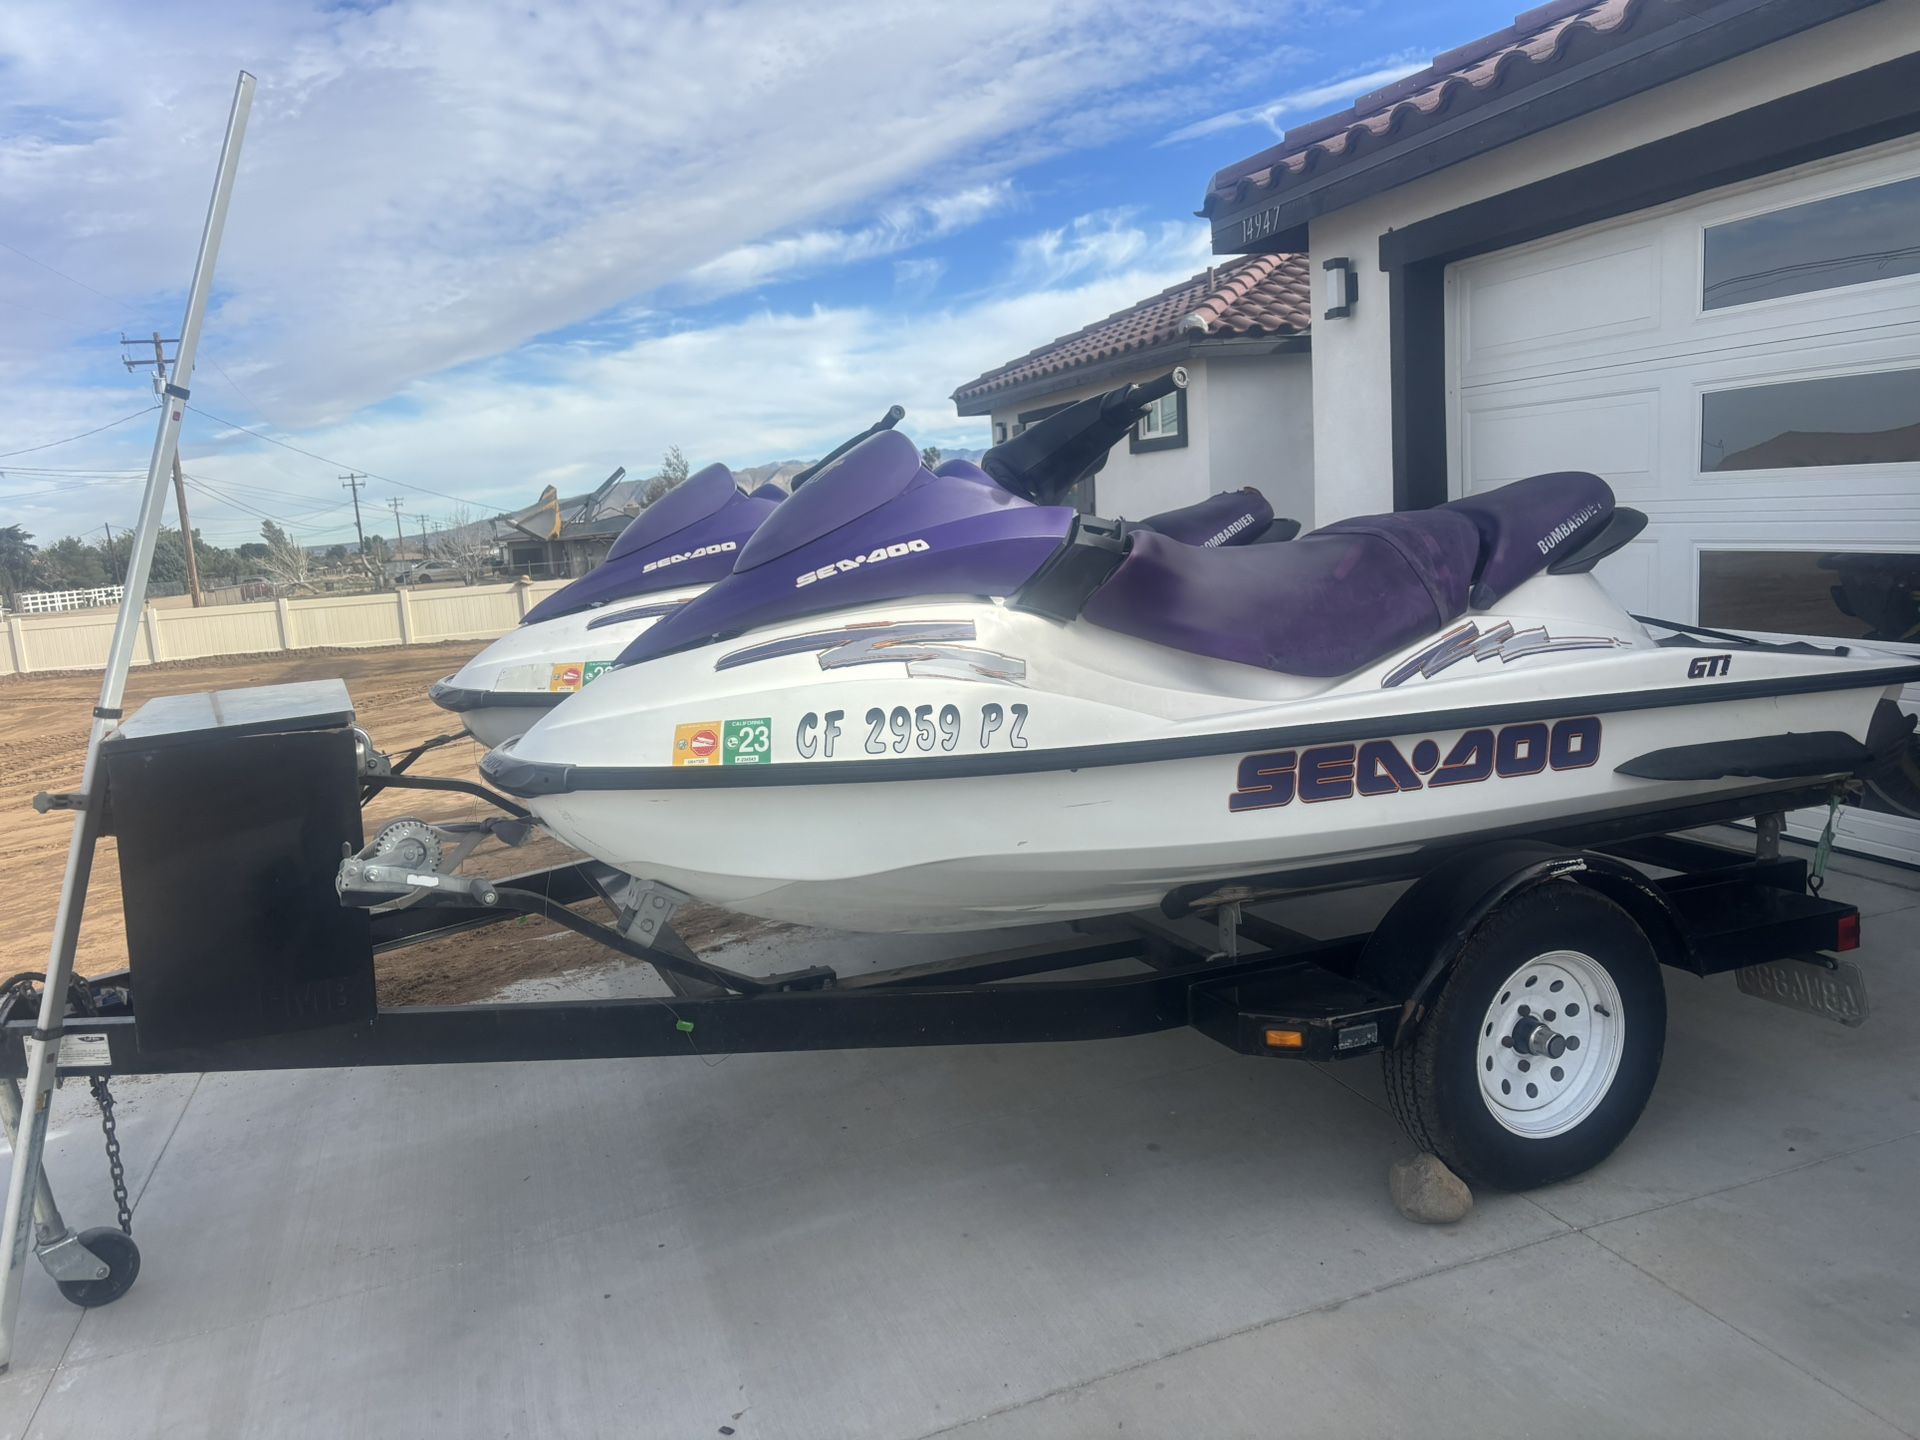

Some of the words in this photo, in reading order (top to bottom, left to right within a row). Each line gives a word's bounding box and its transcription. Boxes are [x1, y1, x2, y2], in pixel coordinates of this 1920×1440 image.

[1242, 205, 1280, 243] 14947
[1201, 513, 1256, 548] OMBARDIER
[738, 725, 769, 752] 23
[796, 709, 844, 759] CF
[864, 703, 961, 755] 2959
[980, 703, 1029, 749] PZ
